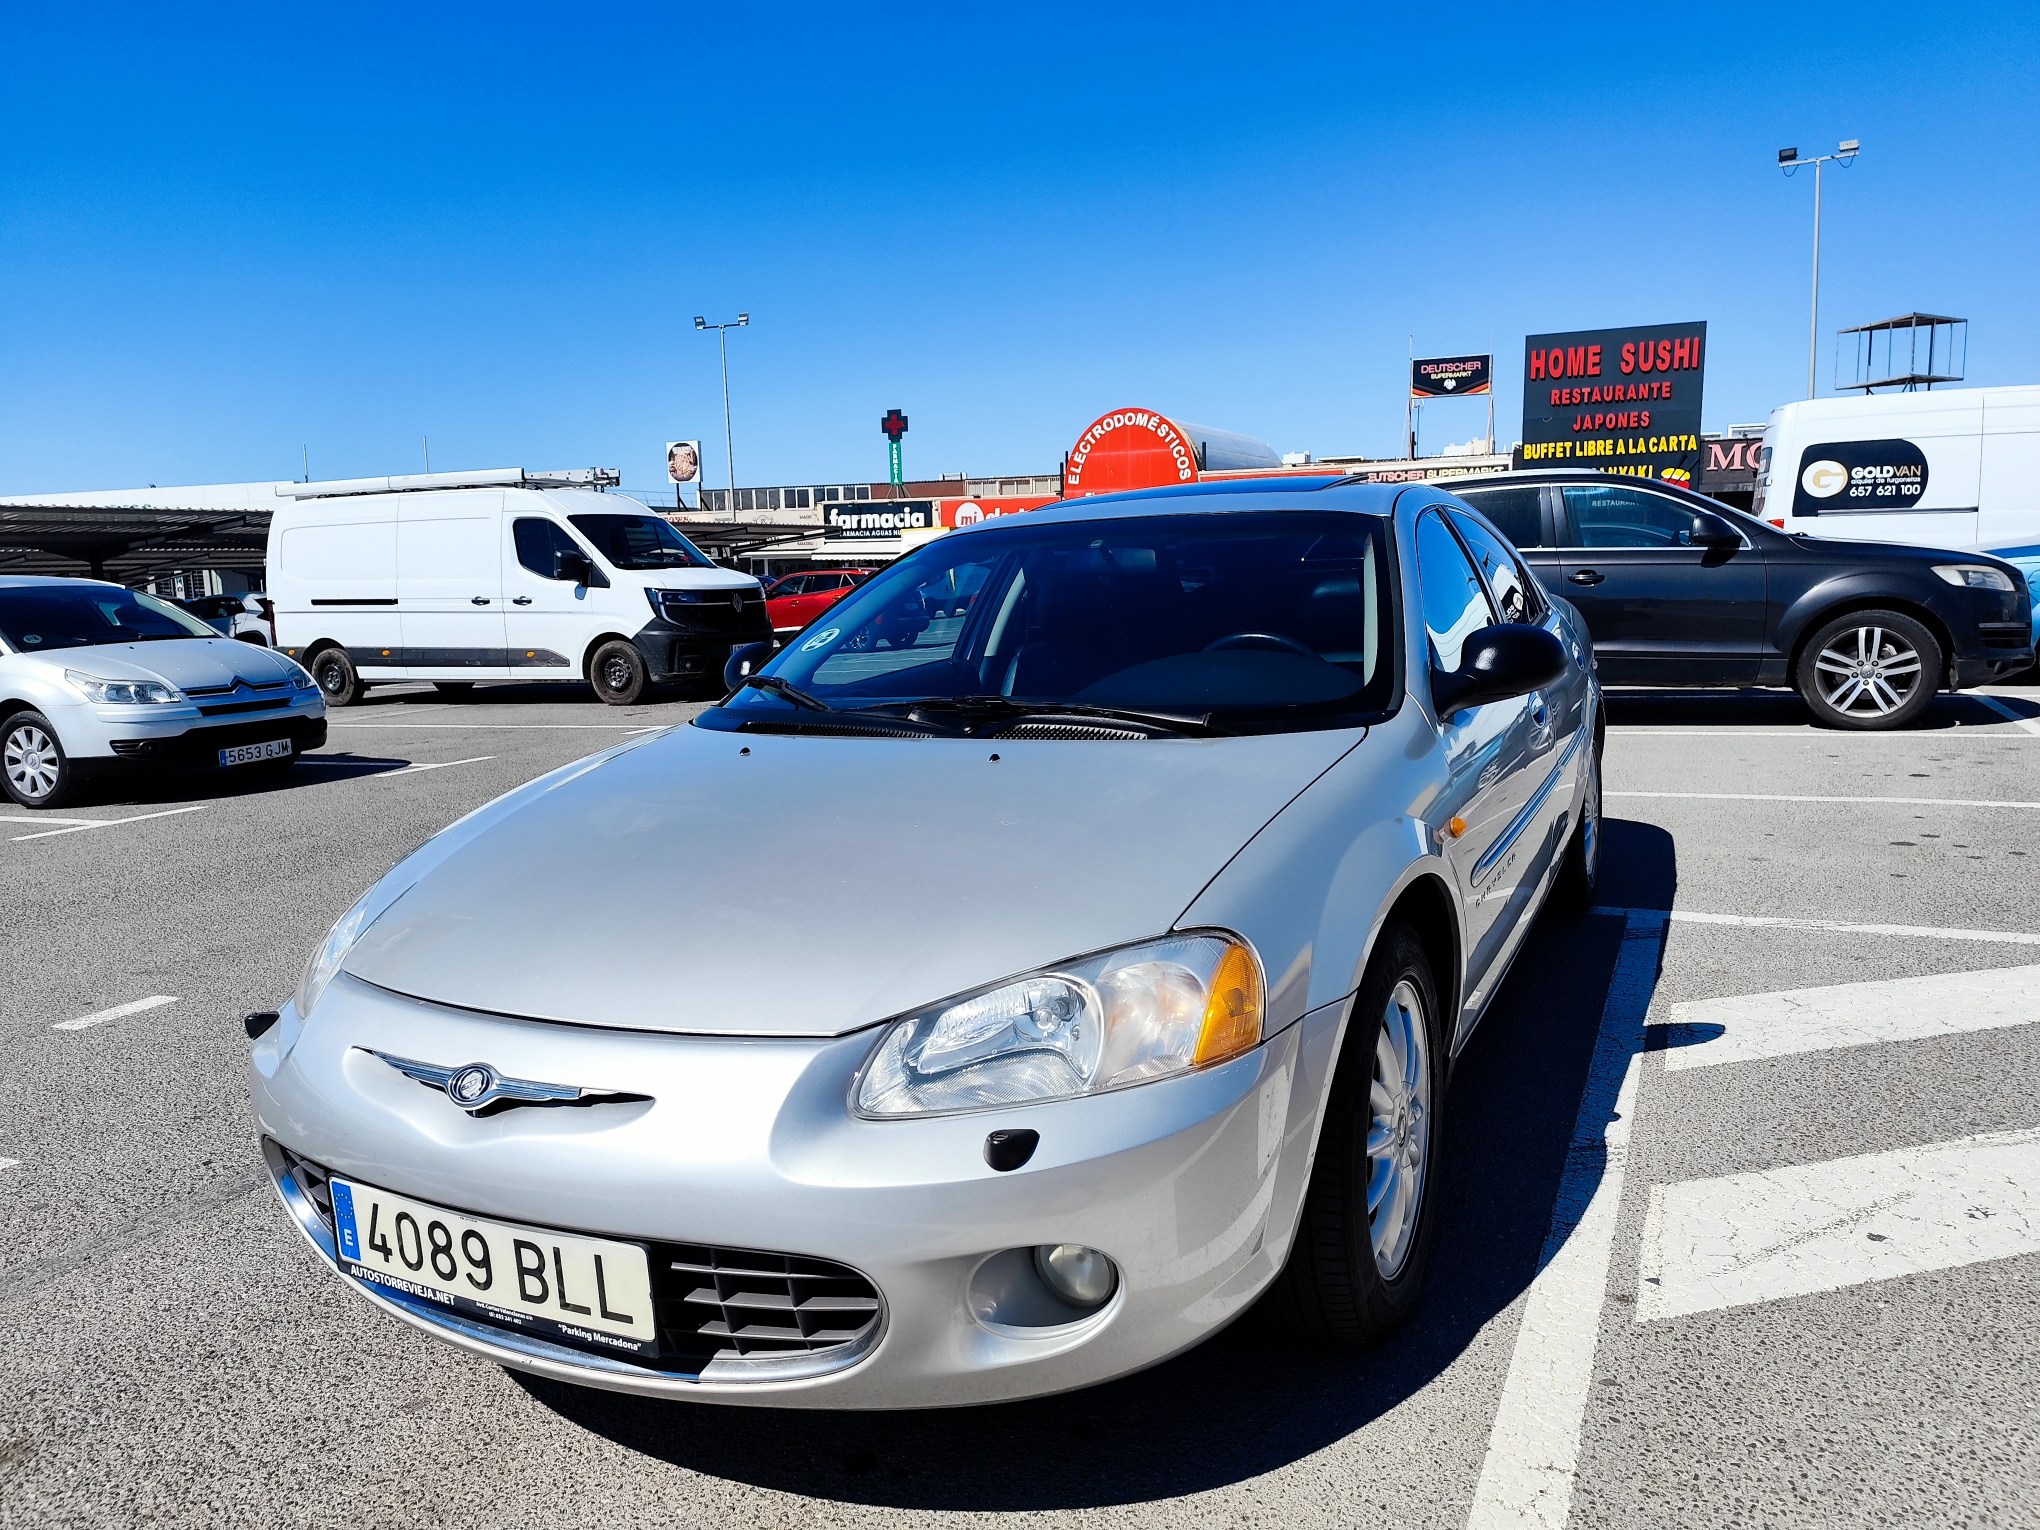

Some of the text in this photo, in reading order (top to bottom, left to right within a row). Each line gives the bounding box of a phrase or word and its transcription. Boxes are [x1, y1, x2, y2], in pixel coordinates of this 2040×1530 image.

[1420, 361, 1482, 374] DEUTSCHER
[1530, 337, 1700, 380] HOME SUSHI
[1430, 371, 1472, 380] SUPERMARKT
[1550, 381, 1672, 406] RESTAURANTE
[1572, 411, 1651, 432] JAPONES
[1068, 412, 1192, 485] ELECTRODOMÉSTICOS
[1523, 434, 1698, 460] BUFFET LIBRE A LA CARTA
[1851, 465, 1921, 479] GOLDVAN
[1849, 484, 1920, 497] 657 621 100
[829, 507, 925, 529] farmacia
[961, 511, 977, 526] mi
[228, 740, 290, 763] 5653 GJM
[343, 1228, 354, 1246] E
[369, 1202, 634, 1325] 4089 BLL
[351, 1264, 455, 1306] AUTOSTORREVIEJA.NET
